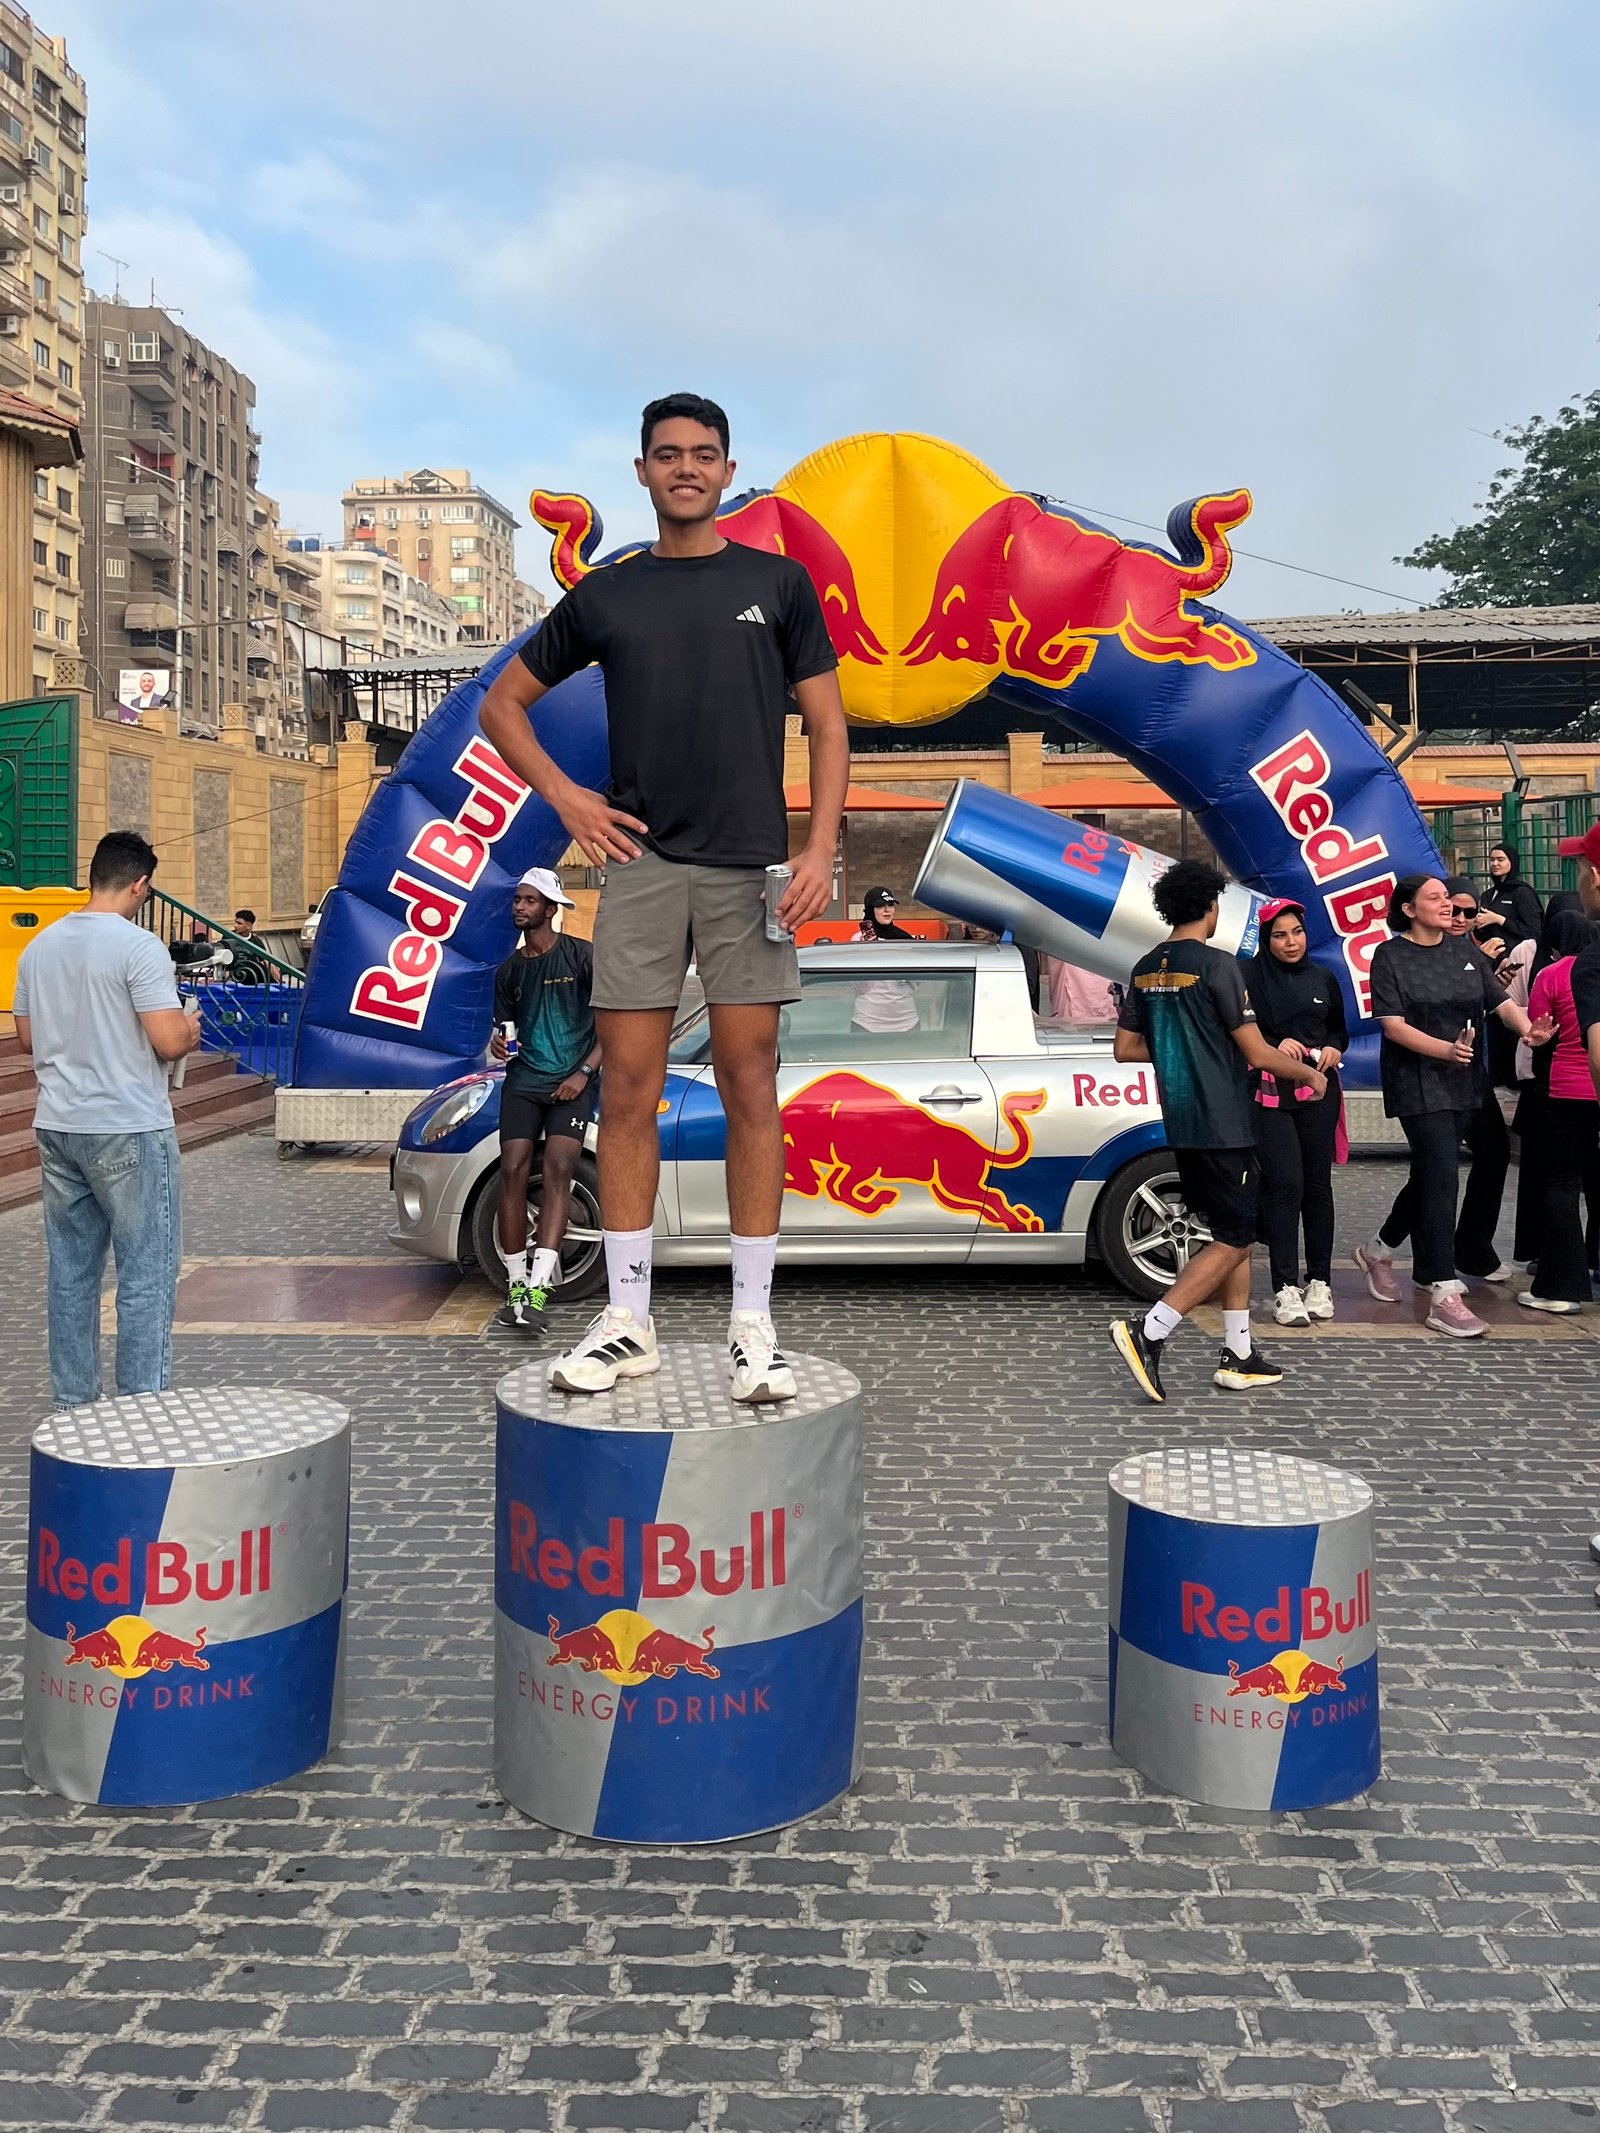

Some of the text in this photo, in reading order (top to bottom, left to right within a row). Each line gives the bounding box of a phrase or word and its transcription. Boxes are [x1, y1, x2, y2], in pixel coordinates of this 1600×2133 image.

[353, 739, 529, 1027] Red Bull
[1253, 732, 1396, 1016] Red Bu
[1241, 928, 1258, 950] With
[1073, 1071, 1148, 1107] Red
[37, 1525, 131, 1606] Red
[144, 1525, 271, 1606] Bull
[510, 1501, 625, 1598] Red
[641, 1507, 786, 1599] Bull
[1181, 1568, 1371, 1642] Red Bull
[40, 1671, 256, 1709] ENERGY DRINK
[518, 1671, 772, 1725] ENERGY DRINK
[1193, 1695, 1368, 1730] ENERGY DRINK
